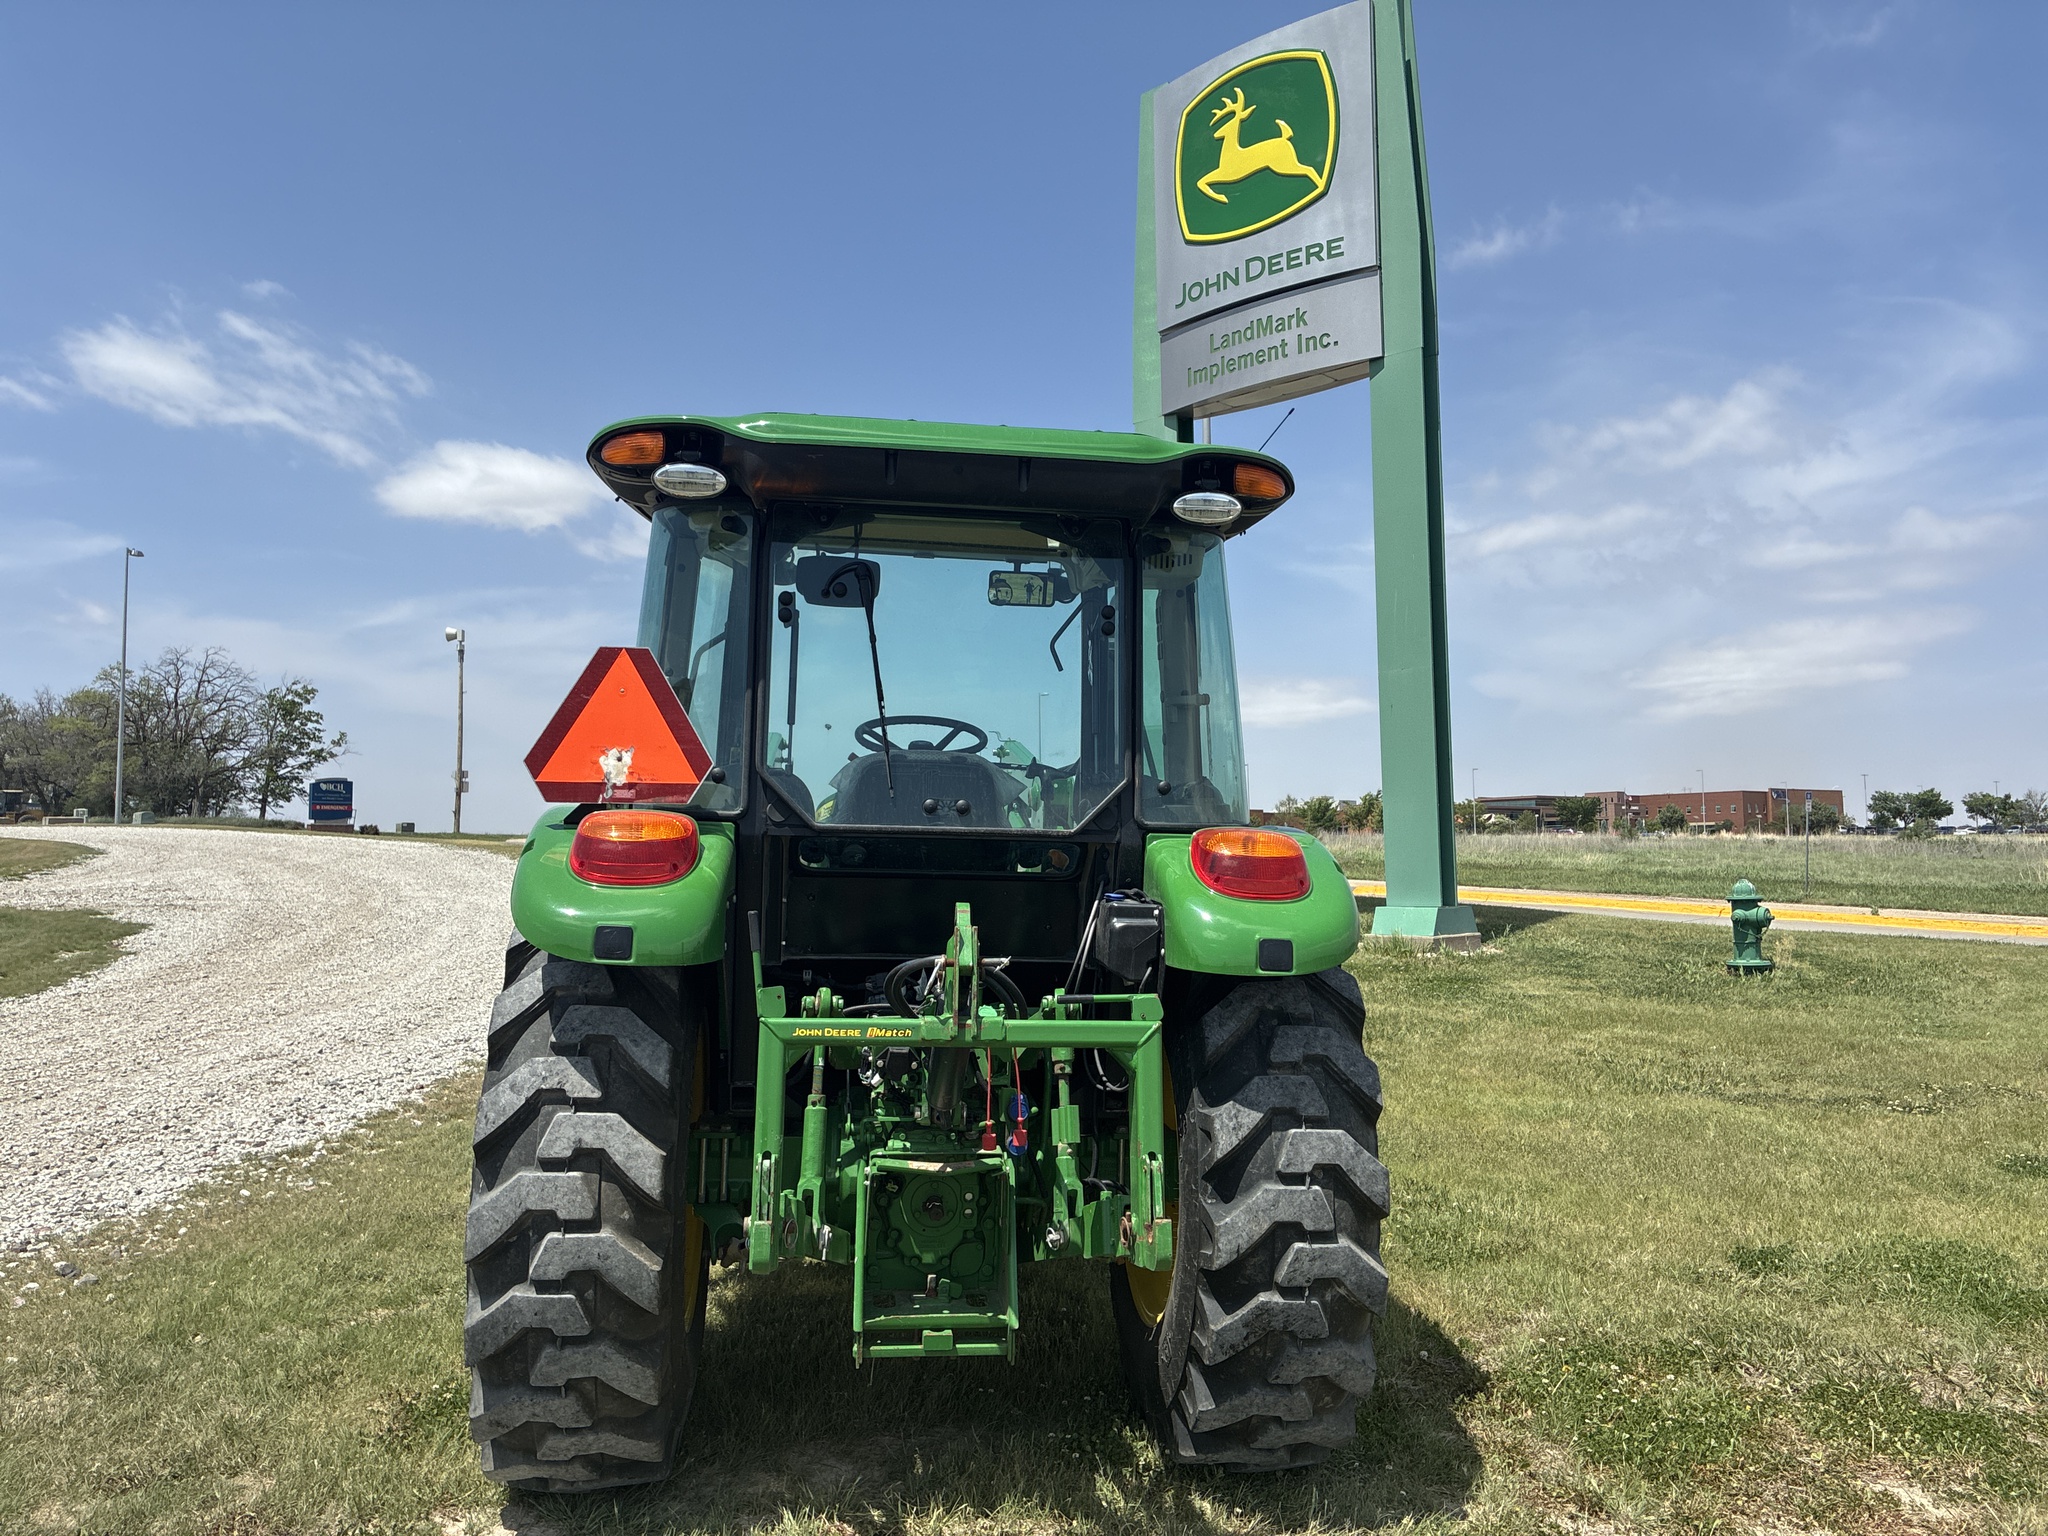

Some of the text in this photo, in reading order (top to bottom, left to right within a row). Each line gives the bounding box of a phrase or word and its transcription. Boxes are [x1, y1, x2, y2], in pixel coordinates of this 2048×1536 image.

[1175, 236, 1344, 309] JOHN DEERE
[1209, 307, 1309, 354] LandMark
[1187, 331, 1339, 388] Implement Inc.
[793, 1027, 822, 1036] JOHN
[825, 1028, 861, 1036] DEERE
